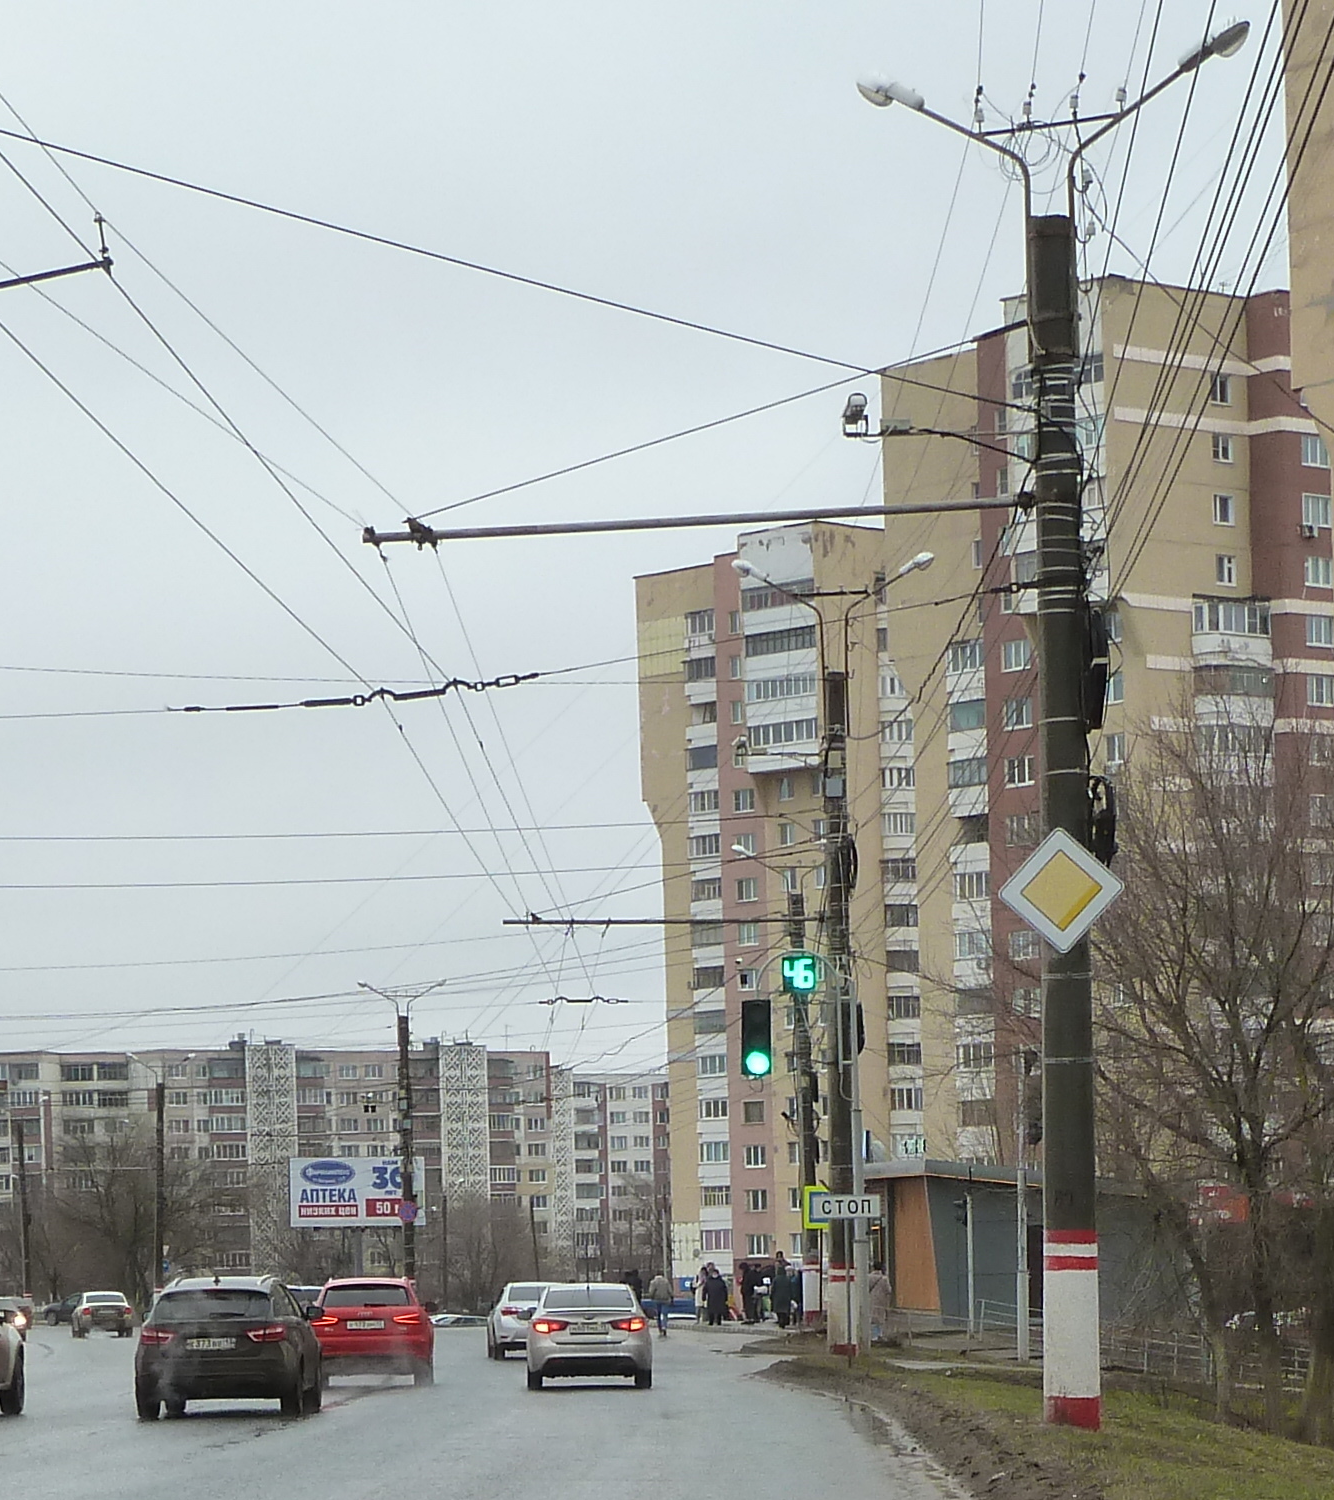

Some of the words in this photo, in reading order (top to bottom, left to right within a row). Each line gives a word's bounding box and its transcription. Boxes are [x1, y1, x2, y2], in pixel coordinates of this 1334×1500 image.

[783, 958, 814, 989] 46
[300, 1188, 357, 1203] АПТЕКА
[376, 1201, 391, 1214] 50
[822, 1199, 871, 1215] СТОП
